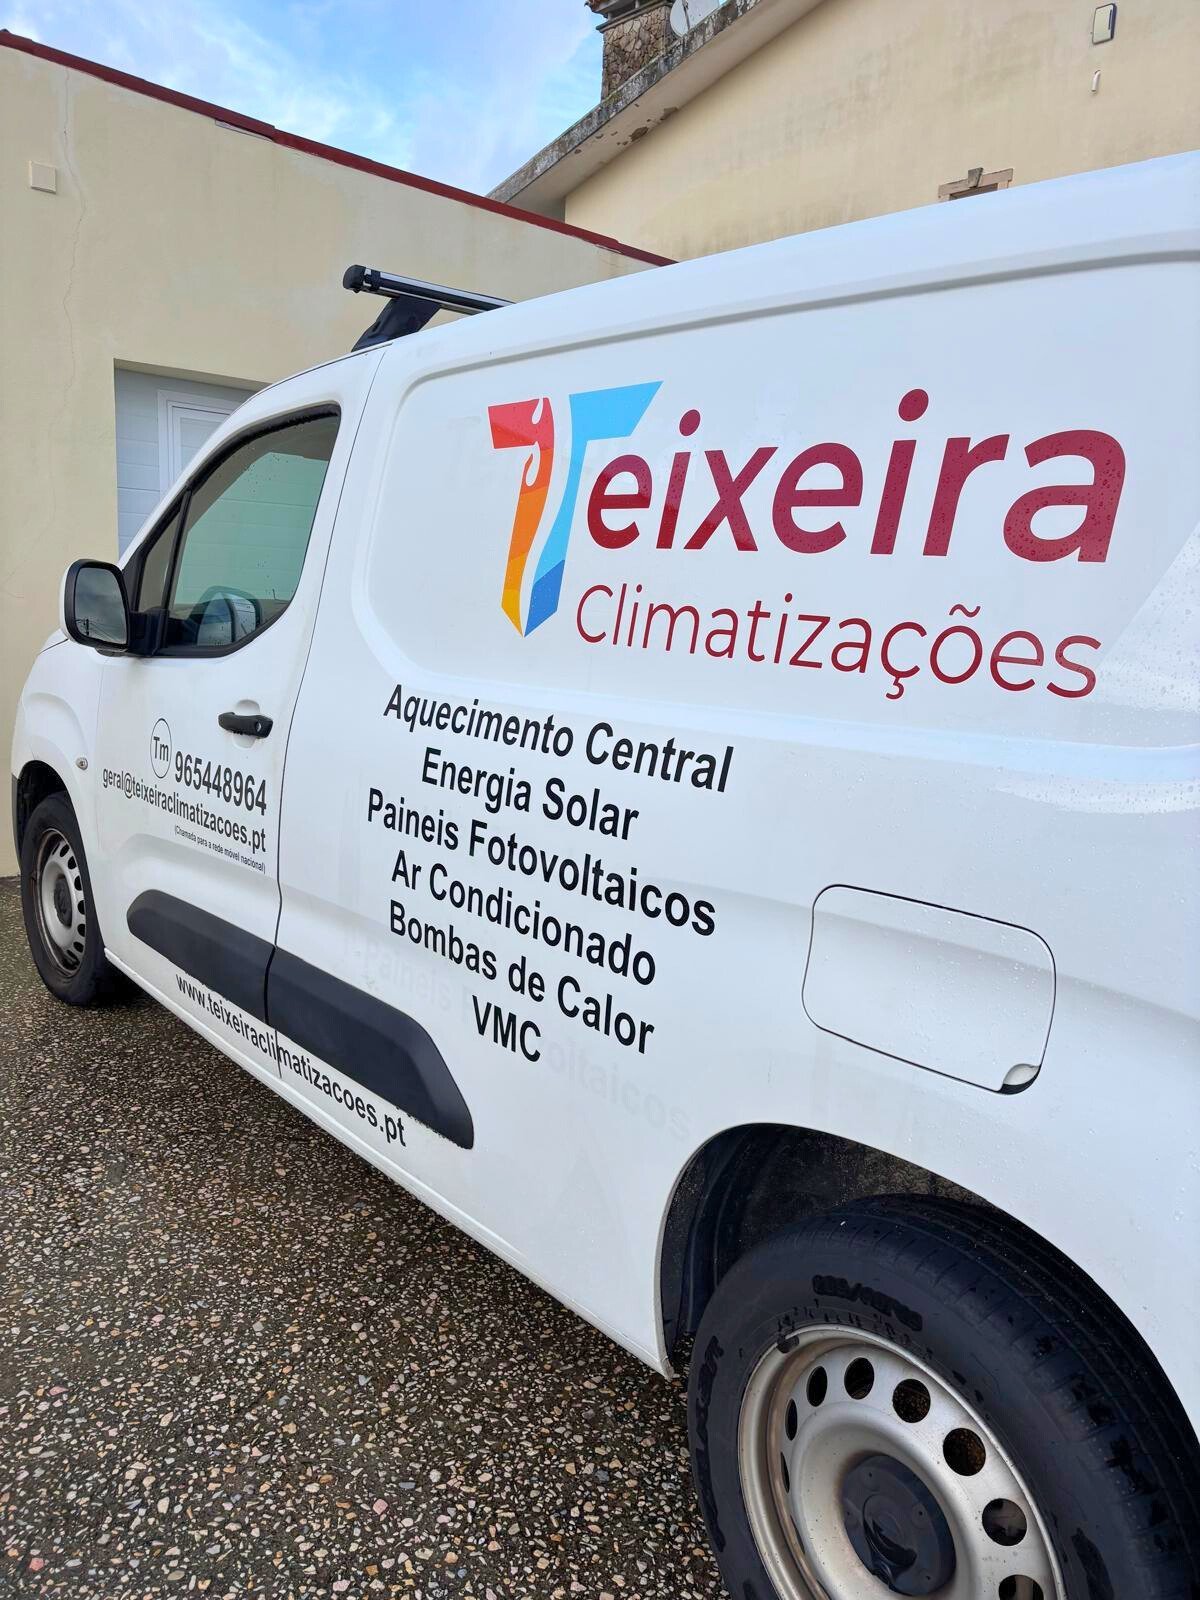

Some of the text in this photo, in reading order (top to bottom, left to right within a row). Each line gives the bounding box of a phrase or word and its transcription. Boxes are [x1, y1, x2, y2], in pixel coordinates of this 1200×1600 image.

[487, 380, 1126, 637] Teixeira
[576, 583, 1101, 699] Climatizações
[174, 750, 267, 817] 965448964
[382, 683, 735, 793] Aquecimento Central
[421, 746, 640, 841] Energia Solar
[102, 768, 267, 855] geral@teixeiraclimatizacoes.pt
[367, 787, 716, 937] Paineis Fotovoltaicos
[391, 849, 422, 891] Ar
[429, 862, 656, 986] Condicionado
[390, 898, 497, 981] Bombas
[507, 955, 546, 1003] de
[557, 975, 655, 1055] Calor
[471, 994, 542, 1063] VMC
[175, 973, 407, 1148] www.teixeiraclimatizacoes.pt
